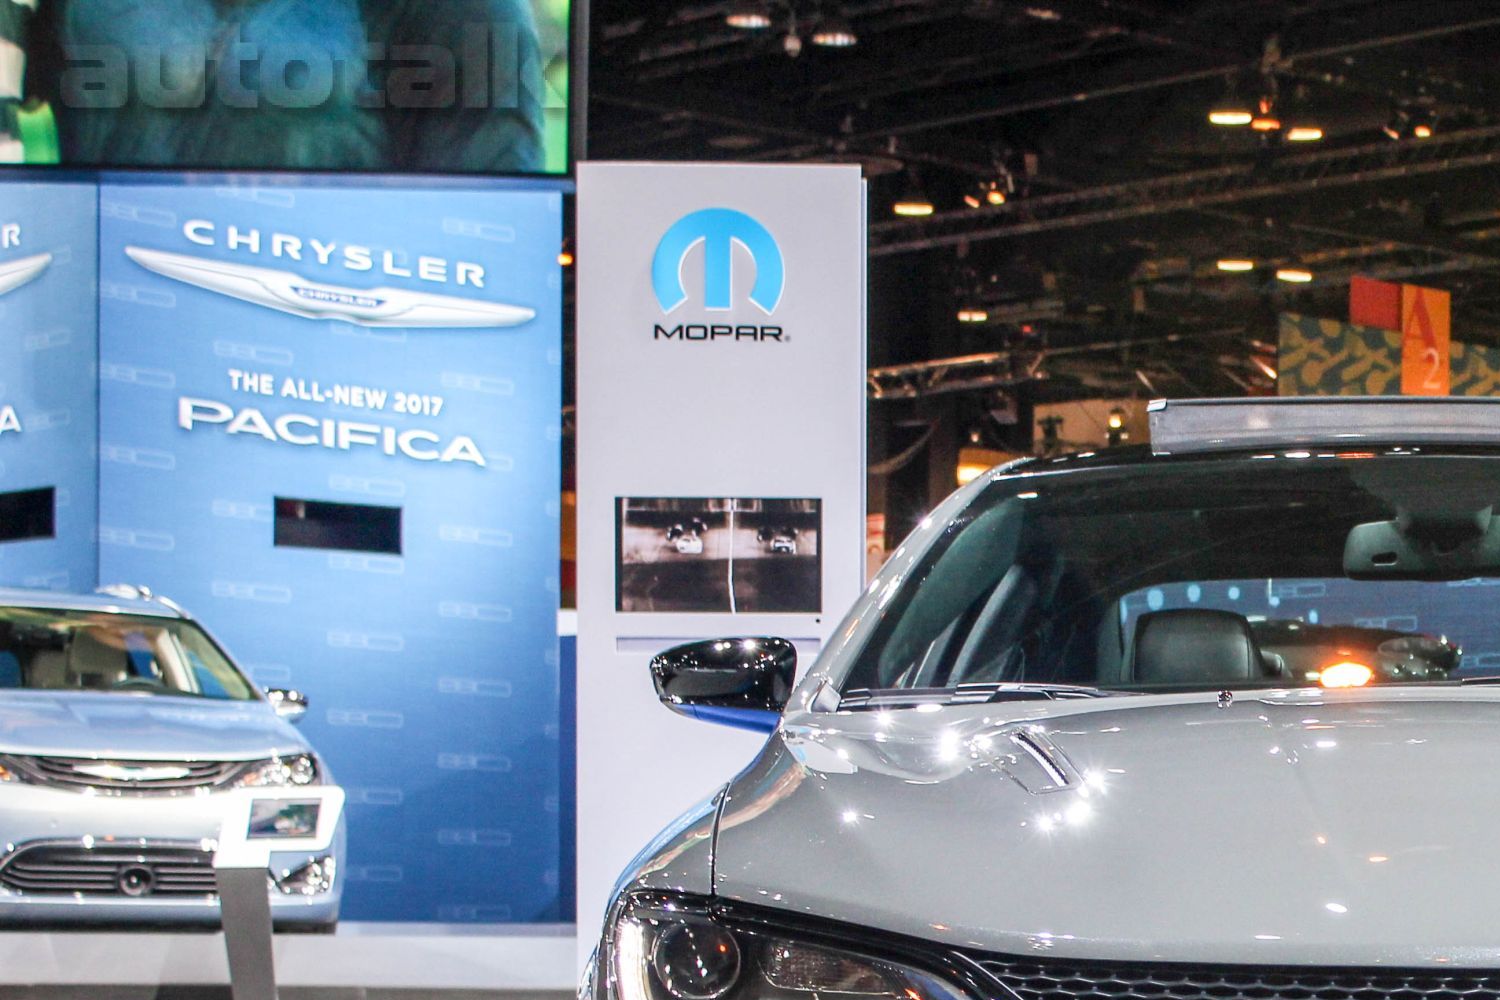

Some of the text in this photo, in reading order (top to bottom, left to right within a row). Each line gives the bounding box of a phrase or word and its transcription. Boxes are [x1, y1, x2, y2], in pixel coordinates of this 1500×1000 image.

[183, 219, 486, 288] CHRYSLER
[228, 368, 444, 417] THE ALL-NEW 2017
[1421, 347, 1441, 389] 2
[178, 396, 487, 467] PACIFICA
